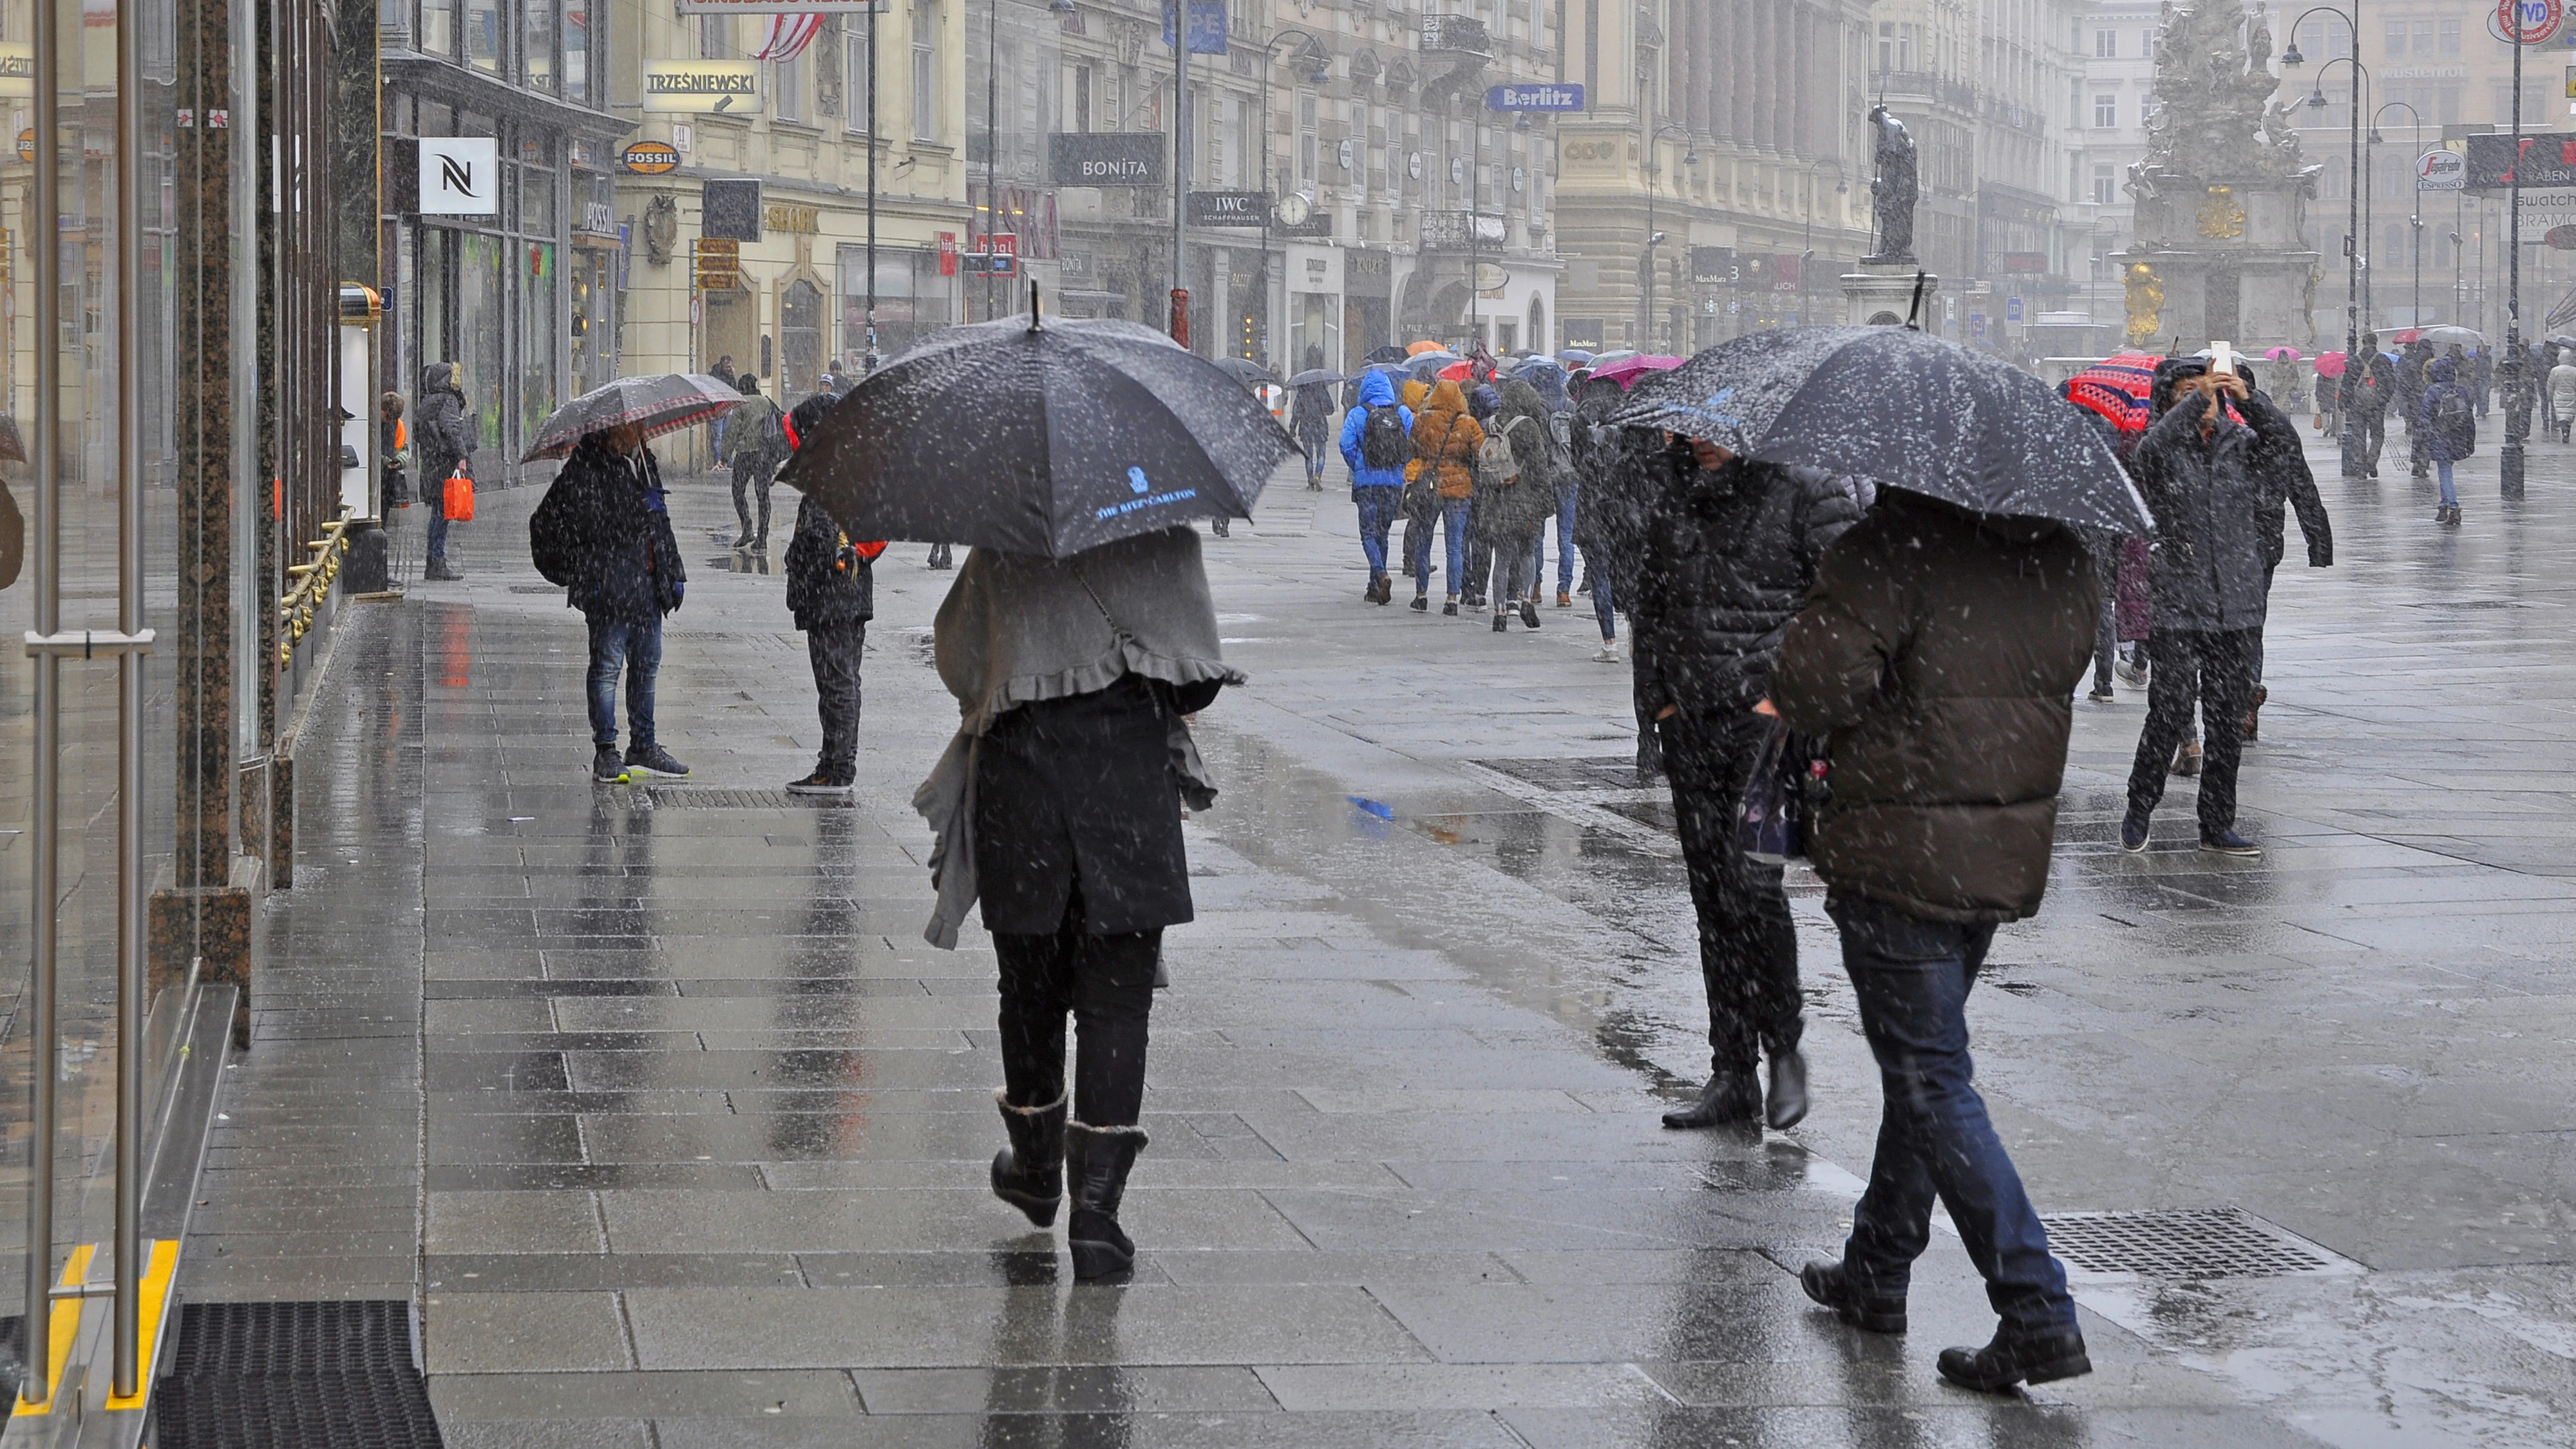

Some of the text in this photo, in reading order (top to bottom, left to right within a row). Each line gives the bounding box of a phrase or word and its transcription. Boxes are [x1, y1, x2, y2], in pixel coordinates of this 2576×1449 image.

[647, 72, 755, 94] TRZEŚNIEWSKI
[1504, 88, 1572, 106] Berlitz
[627, 153, 676, 163] FOSSIL
[2521, 170, 2570, 182] RABEN
[1215, 197, 1249, 211] IWC
[587, 202, 613, 233] FOSSIL
[942, 238, 955, 254] högl
[1695, 274, 1727, 283] MaxMara
[1774, 281, 1795, 290] UCH
